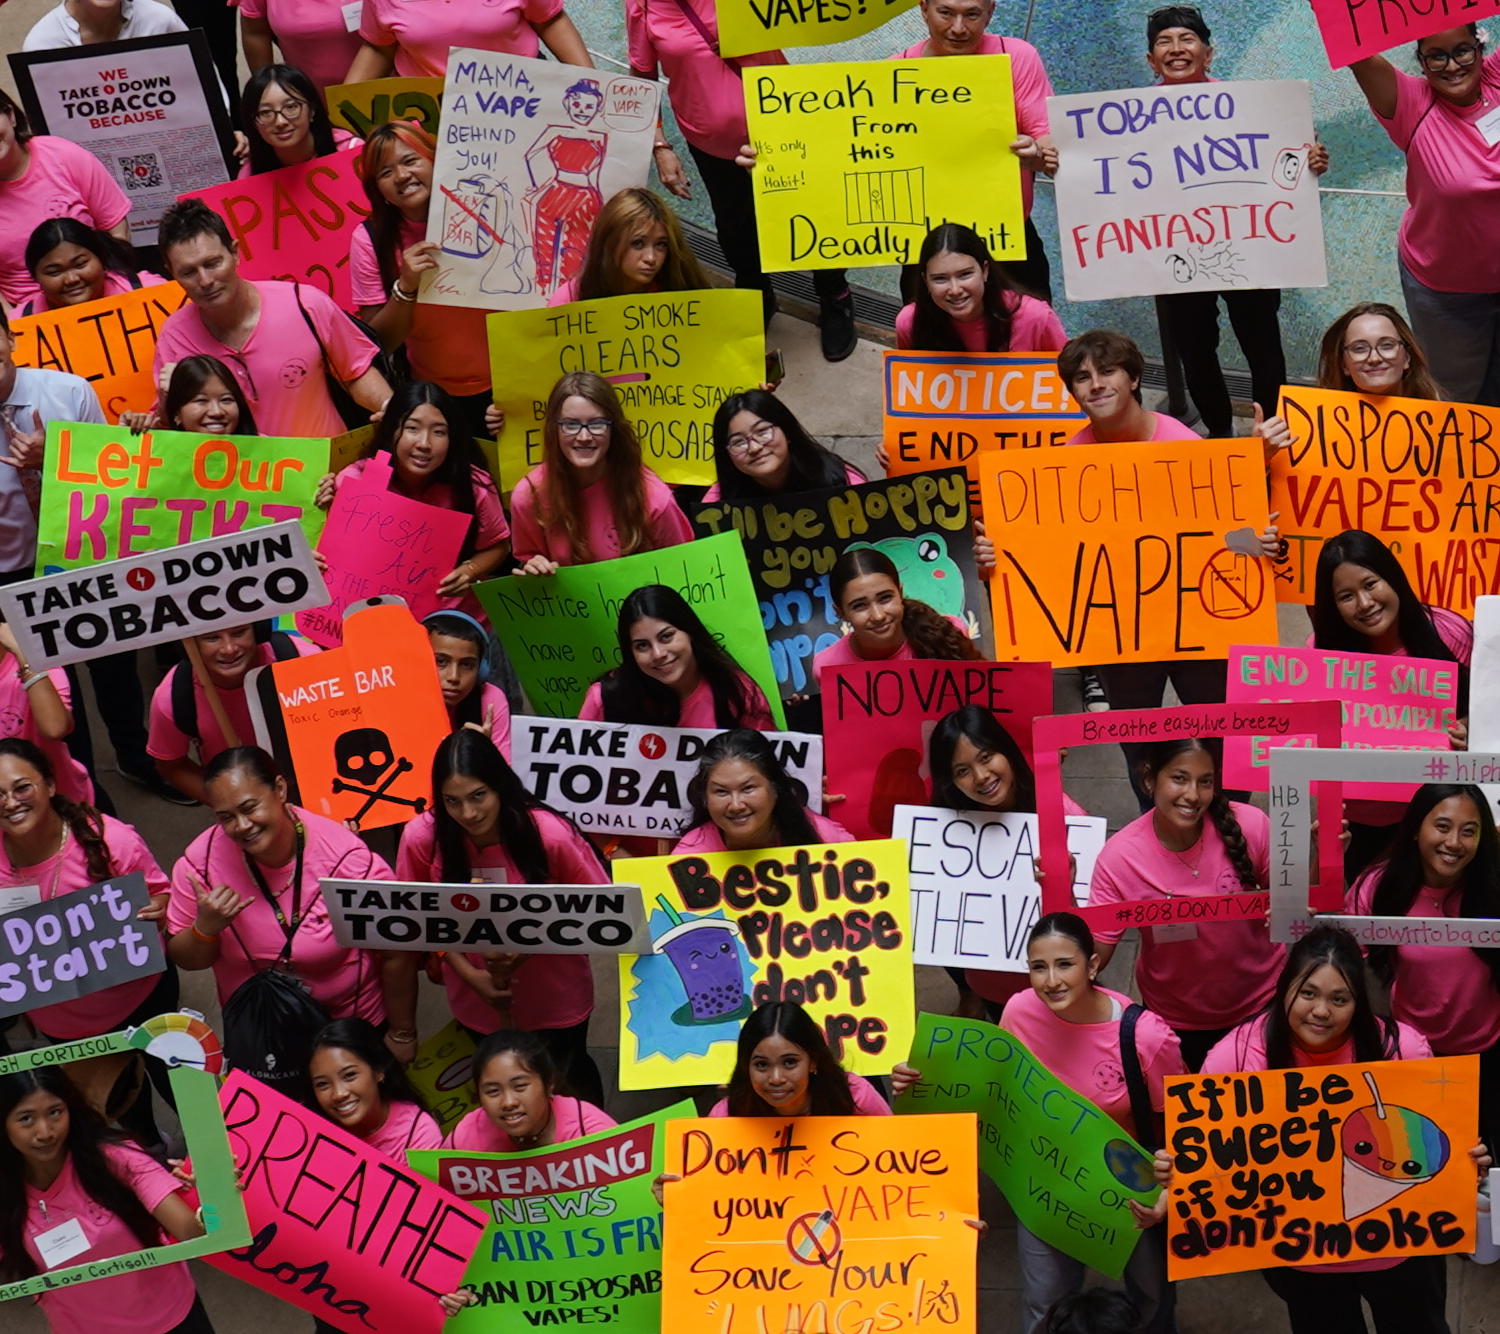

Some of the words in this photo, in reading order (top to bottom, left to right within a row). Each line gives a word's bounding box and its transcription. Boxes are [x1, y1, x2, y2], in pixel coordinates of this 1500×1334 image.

[59, 87, 99, 101] TAKE
[119, 76, 170, 94] DOWN
[99, 68, 128, 82] WE
[456, 62, 535, 92] MAMA,
[757, 74, 875, 117] Break
[893, 67, 972, 106] Free
[64, 90, 176, 119] TOBACCO
[89, 110, 166, 129] BECAUSE
[453, 95, 468, 113] A
[476, 91, 542, 118] VAPE
[1066, 92, 1235, 139] TOBACCO
[447, 125, 515, 144] BEHIND
[852, 116, 918, 137] From
[849, 142, 895, 161] this
[789, 214, 910, 265] Deadly
[1072, 200, 1297, 269] FANTASTIC
[548, 312, 597, 337] THE
[624, 300, 701, 331] SMOKE
[559, 334, 681, 375] CLEARS
[899, 371, 1072, 413] NOTICE!
[56, 429, 164, 488] Let
[193, 440, 304, 491] Our
[900, 430, 978, 463] END
[997, 465, 1140, 525] DITCH
[1161, 455, 1246, 522] THE
[1289, 475, 1443, 534] VAPES
[16, 573, 119, 618] TAKE
[165, 534, 294, 586] DOWN
[1002, 532, 1215, 656] VAPE
[31, 567, 310, 658] TOBACCO
[500, 586, 590, 624] Notice
[279, 678, 344, 708] WASTE
[355, 666, 396, 694] BAR
[1240, 654, 1309, 687] END
[1323, 658, 1378, 692] THE
[1389, 661, 1453, 700] SALE
[528, 725, 630, 759] TAKE
[667, 848, 889, 912] Bestie,
[2, 884, 132, 956] Don't
[335, 889, 440, 912] TAKE
[489, 893, 625, 915] DOWN
[343, 915, 633, 948] TOBACCO
[929, 1024, 1099, 1135] PROTECT
[1167, 1072, 1264, 1123] It'll
[1284, 1071, 1353, 1112] be
[450, 1140, 646, 1196] BREAKING
[224, 1087, 485, 1299] BREATHE
[493, 1187, 616, 1224] NEWS
[491, 1229, 547, 1264] AIR
[565, 1224, 606, 1259] IS
[522, 1304, 620, 1328] VAPES!
